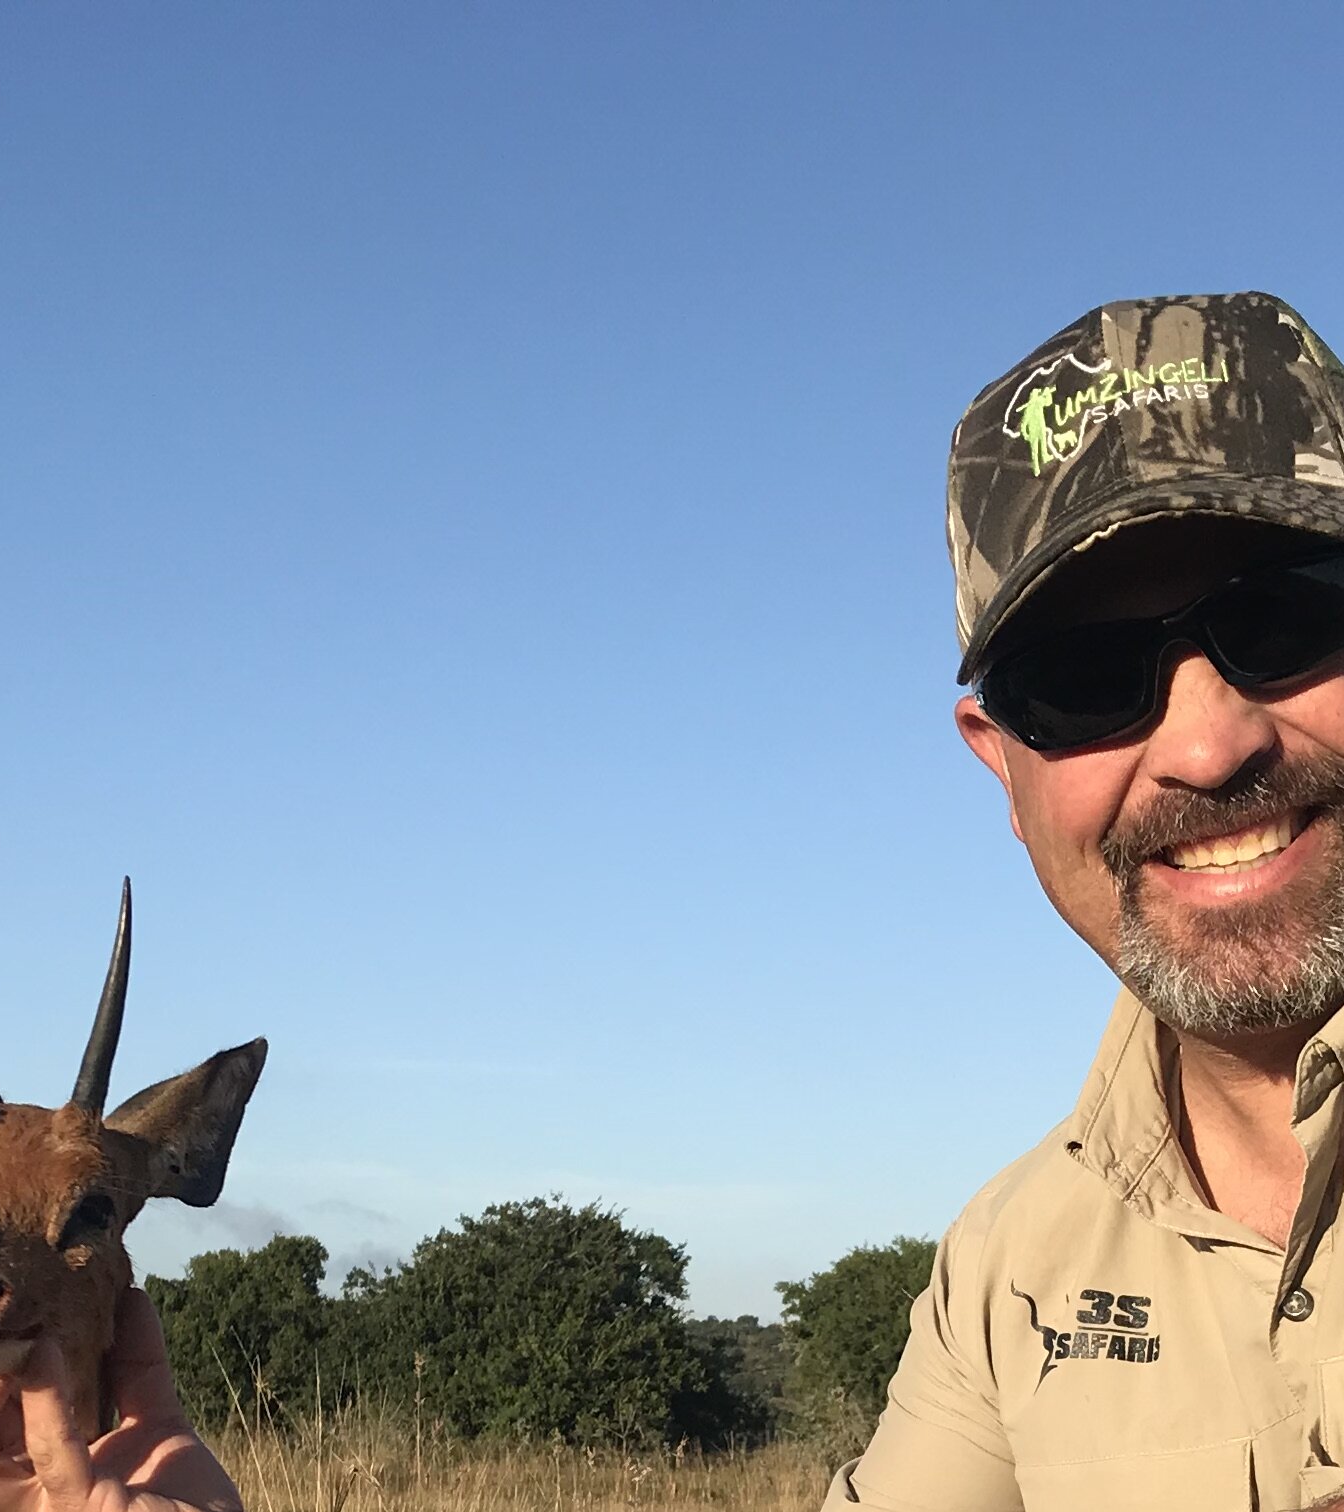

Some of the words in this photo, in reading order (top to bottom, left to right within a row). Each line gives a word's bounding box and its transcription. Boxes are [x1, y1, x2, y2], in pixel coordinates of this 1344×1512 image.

[1054, 358, 1229, 426] UMZINGELI
[1090, 383, 1210, 424] SAFARIS
[1076, 1289, 1152, 1329] 3S
